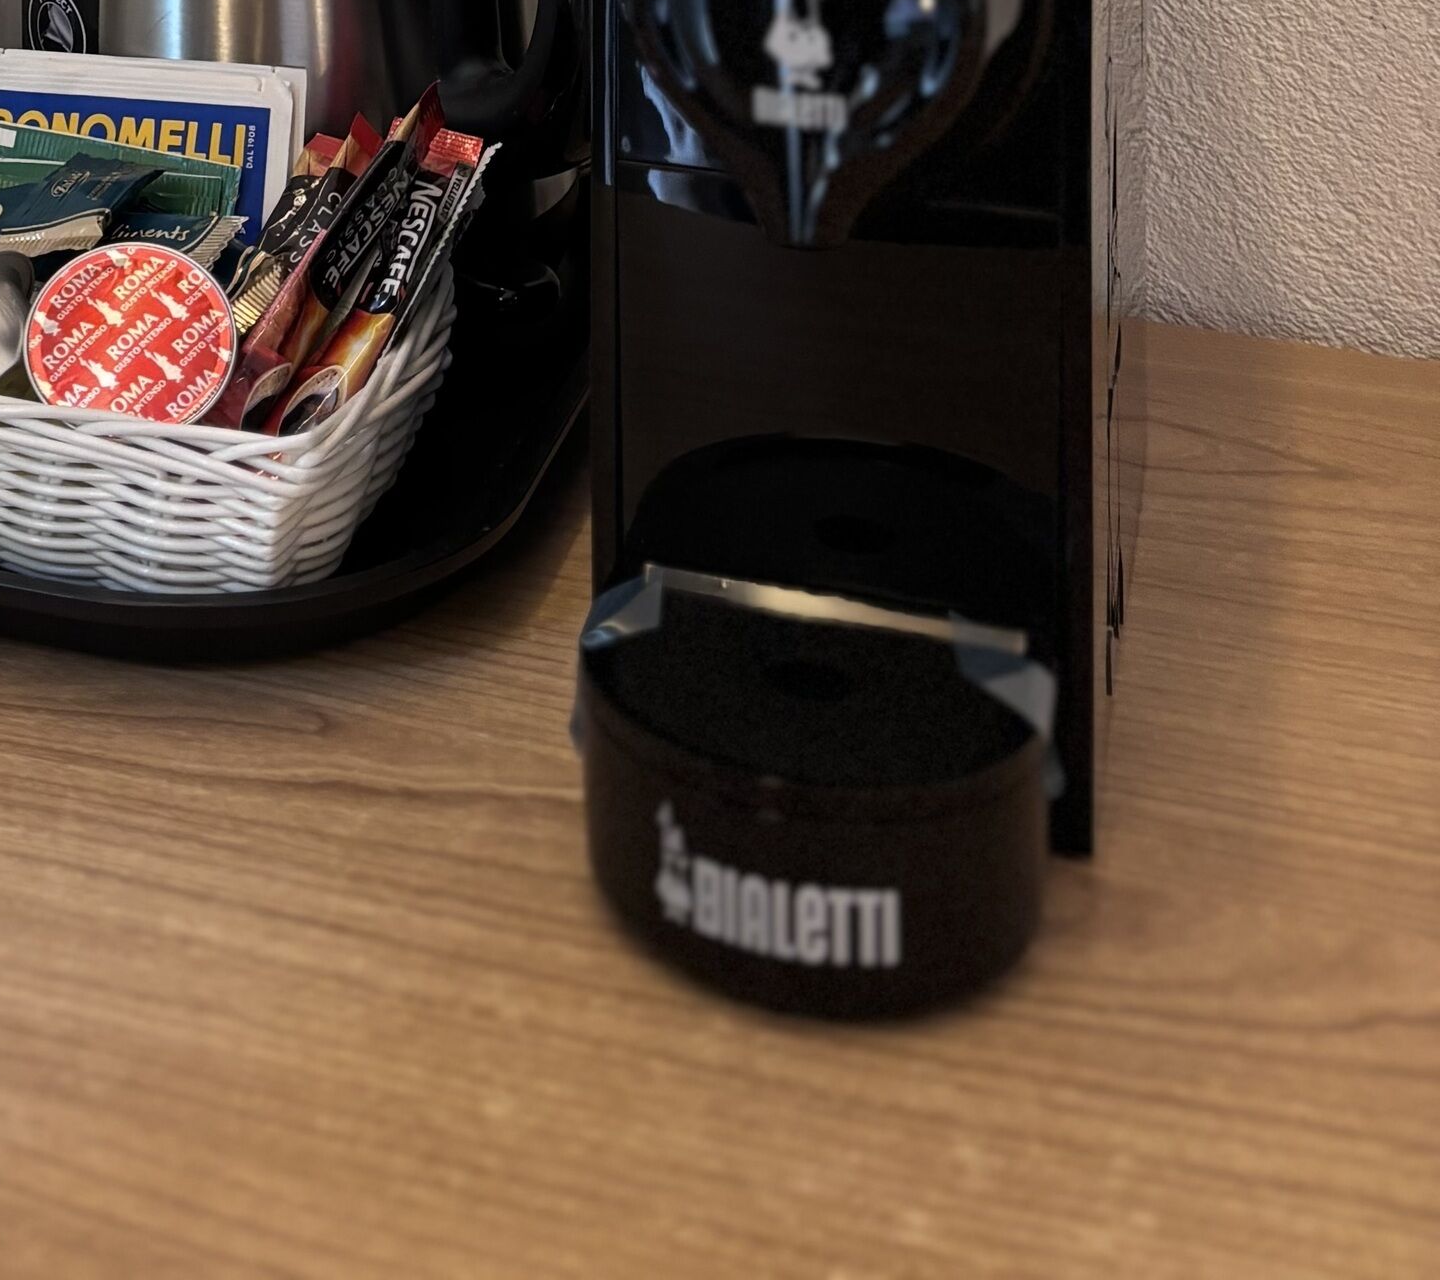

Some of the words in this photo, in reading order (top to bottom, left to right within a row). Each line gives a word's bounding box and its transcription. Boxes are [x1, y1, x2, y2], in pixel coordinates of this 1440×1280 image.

[247, 125, 256, 147] 1908
[50, 263, 103, 309] ROMA
[57, 294, 84, 321] GUSTO
[82, 266, 114, 298] INTENSO
[113, 256, 165, 300] ROMA
[120, 286, 147, 312] GUSTO
[144, 259, 179, 291] INTENSO
[184, 281, 212, 306] GUSTO
[42, 321, 95, 370] ROMA
[49, 355, 77, 383] GUSTO
[74, 324, 108, 357] INTENSO
[106, 313, 160, 361] ROMA
[113, 347, 141, 374] GUSTO
[138, 317, 173, 349] INTENSO
[171, 308, 225, 355] ROMA
[179, 341, 207, 367] GUSTO
[133, 380, 167, 412] INTENSO
[165, 369, 220, 418] ROMA
